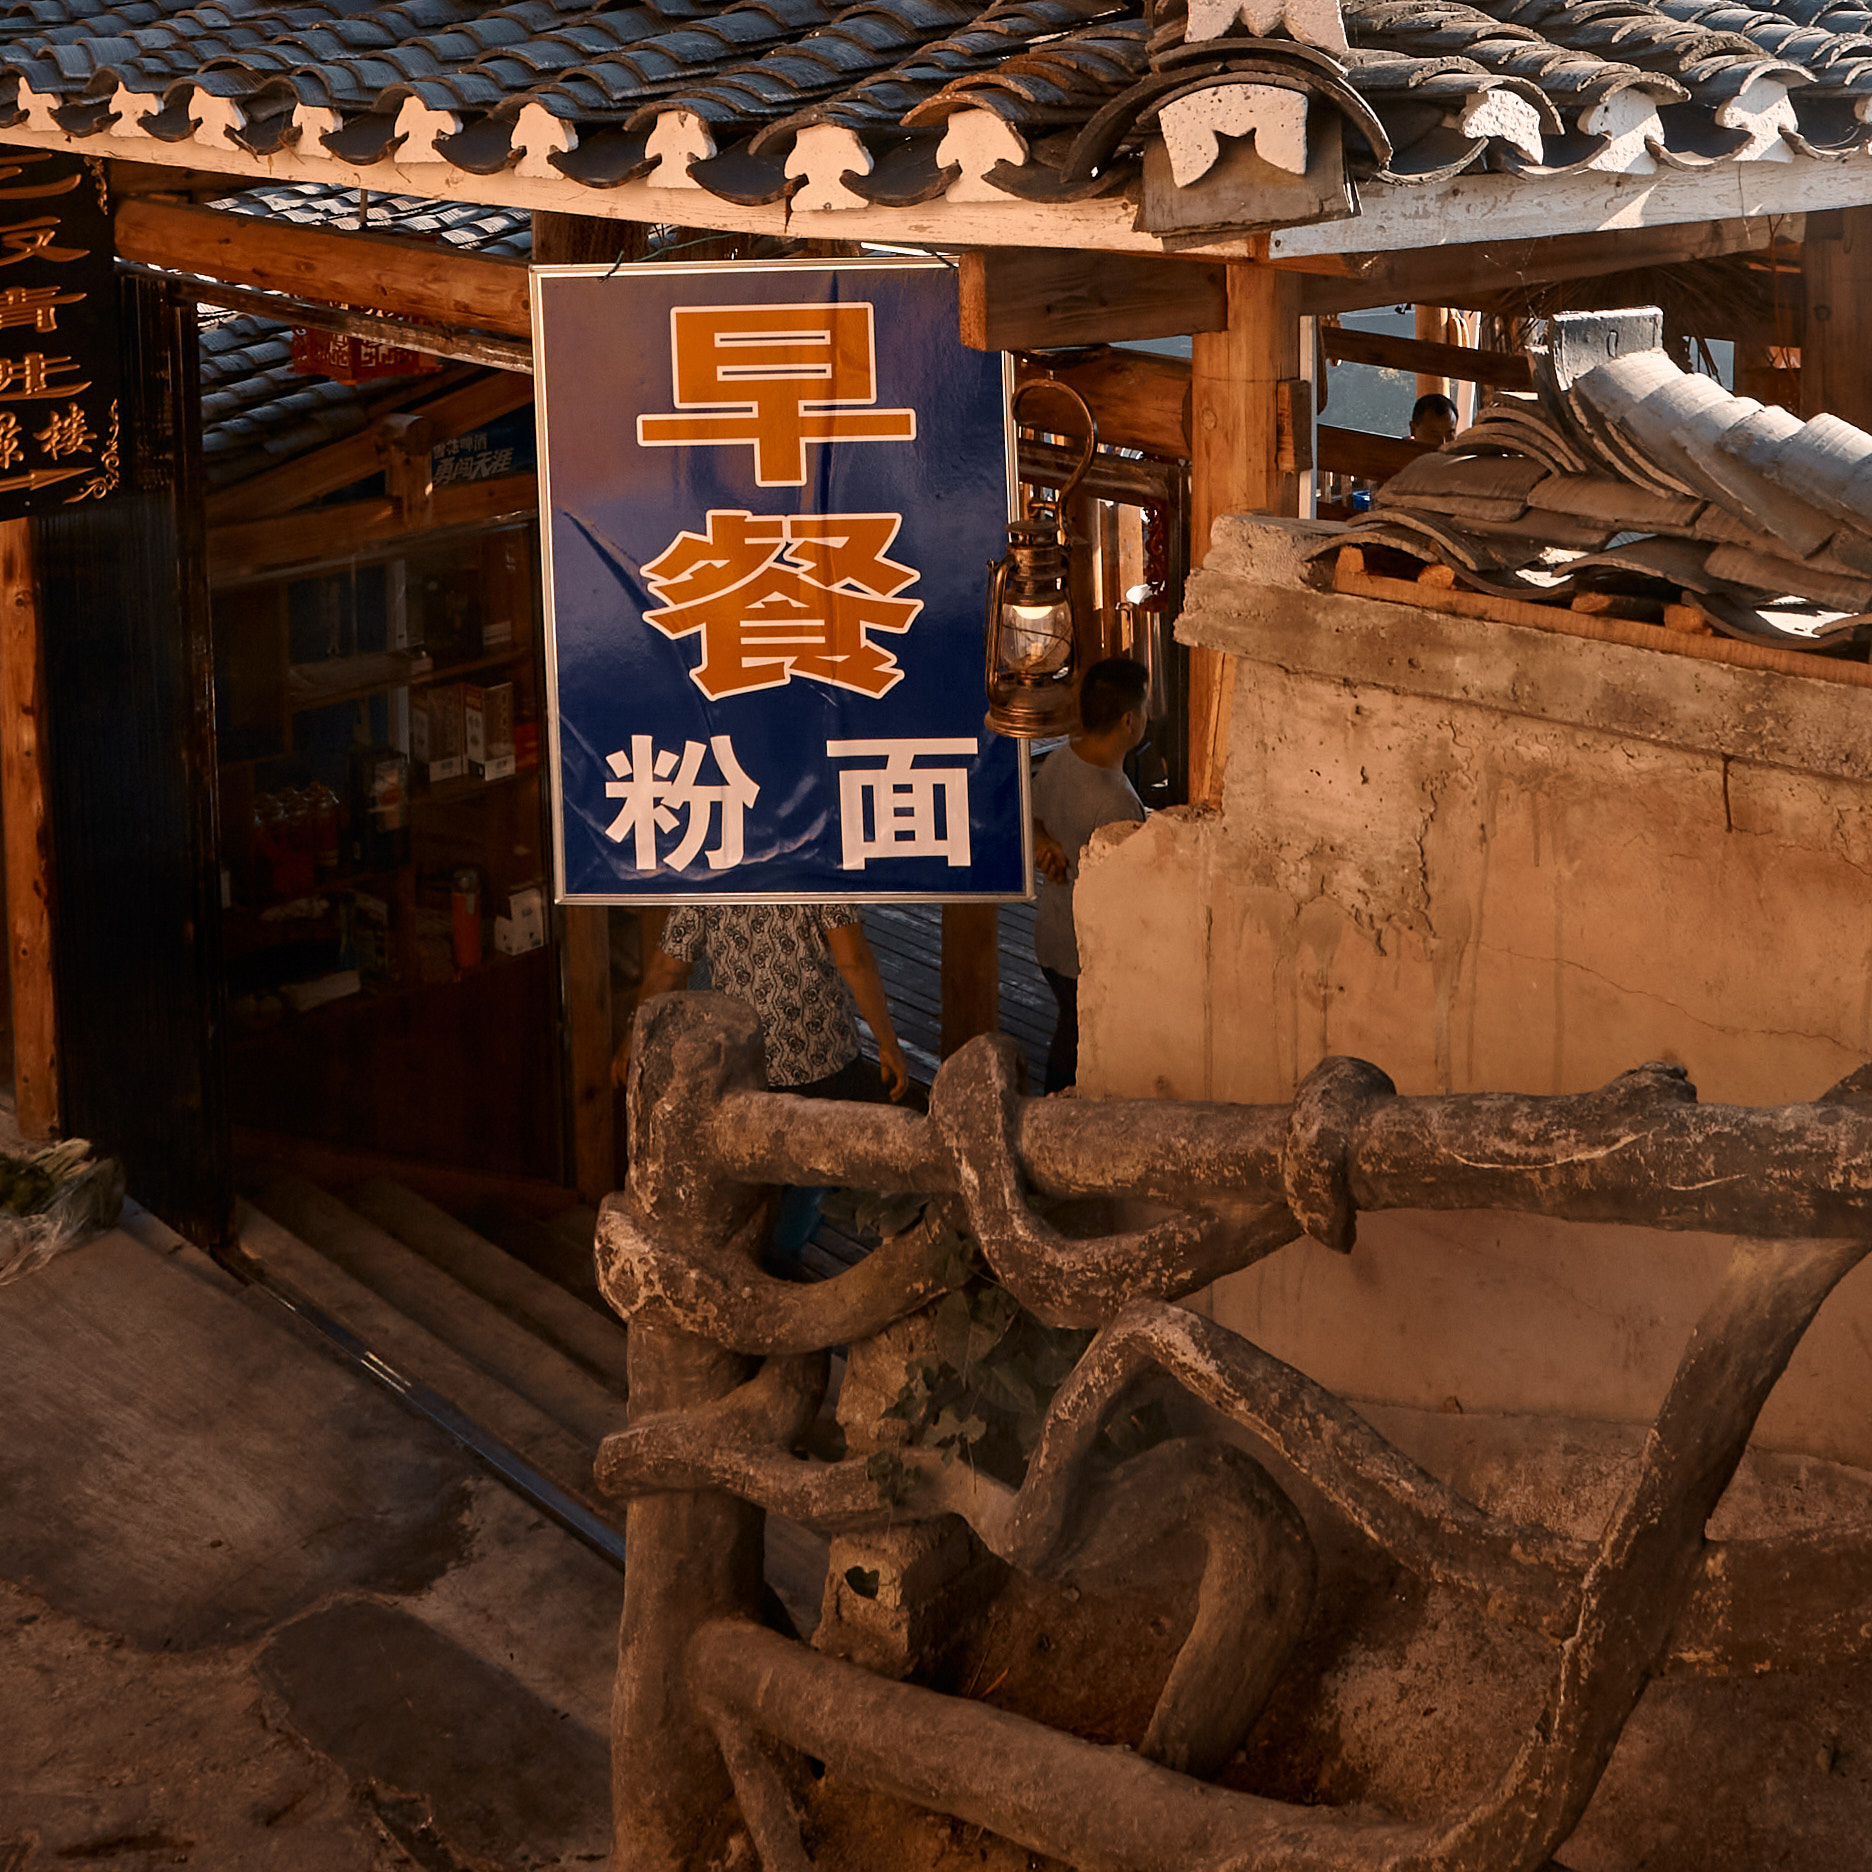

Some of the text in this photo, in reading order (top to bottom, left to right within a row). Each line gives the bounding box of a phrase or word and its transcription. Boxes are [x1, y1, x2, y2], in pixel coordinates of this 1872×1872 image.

[433, 447, 515, 486] 勇闯天涯
[635, 301, 925, 701] 早餐
[604, 734, 978, 873] 粉面
